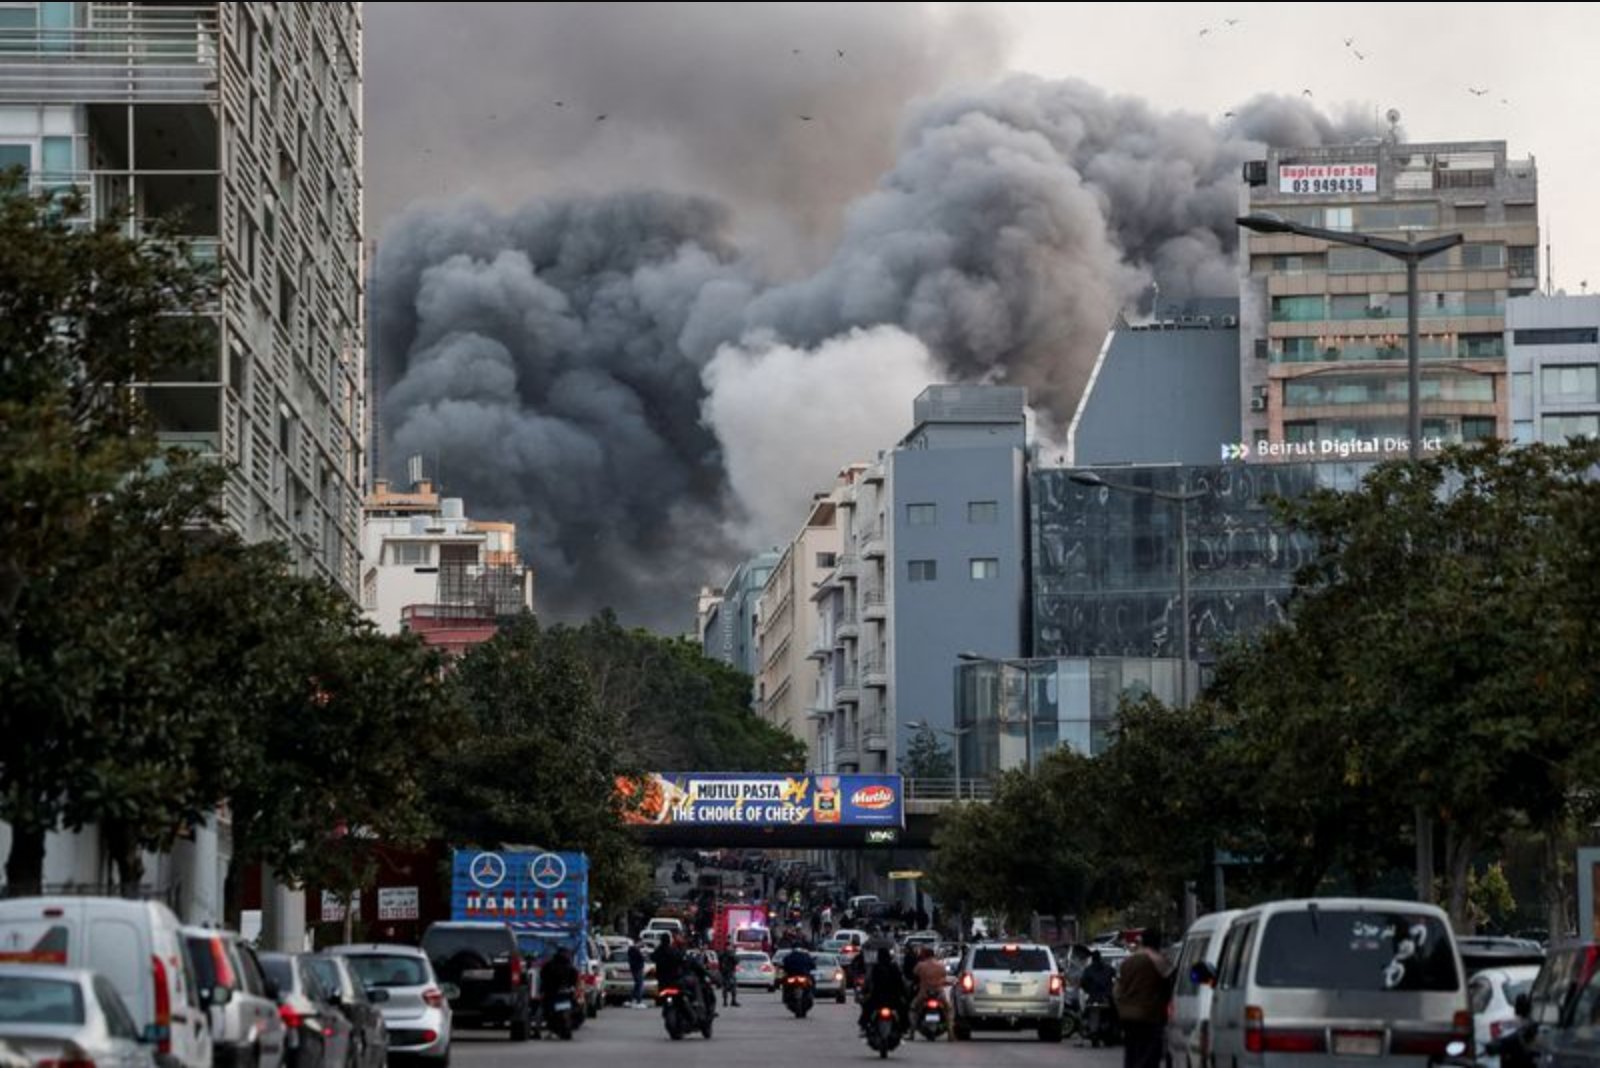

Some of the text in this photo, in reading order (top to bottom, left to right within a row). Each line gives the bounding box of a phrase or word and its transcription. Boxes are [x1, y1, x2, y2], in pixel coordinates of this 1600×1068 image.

[1327, 166, 1346, 177] For
[1350, 165, 1376, 177] Sale
[1293, 179, 1363, 192] 03 949435
[1257, 437, 1442, 457] Beirut Digital Disict
[698, 783, 781, 799] MUTLU PASTA
[852, 788, 893, 804] Mutlu
[672, 805, 804, 822] THE CHOICE OF CHEFS
